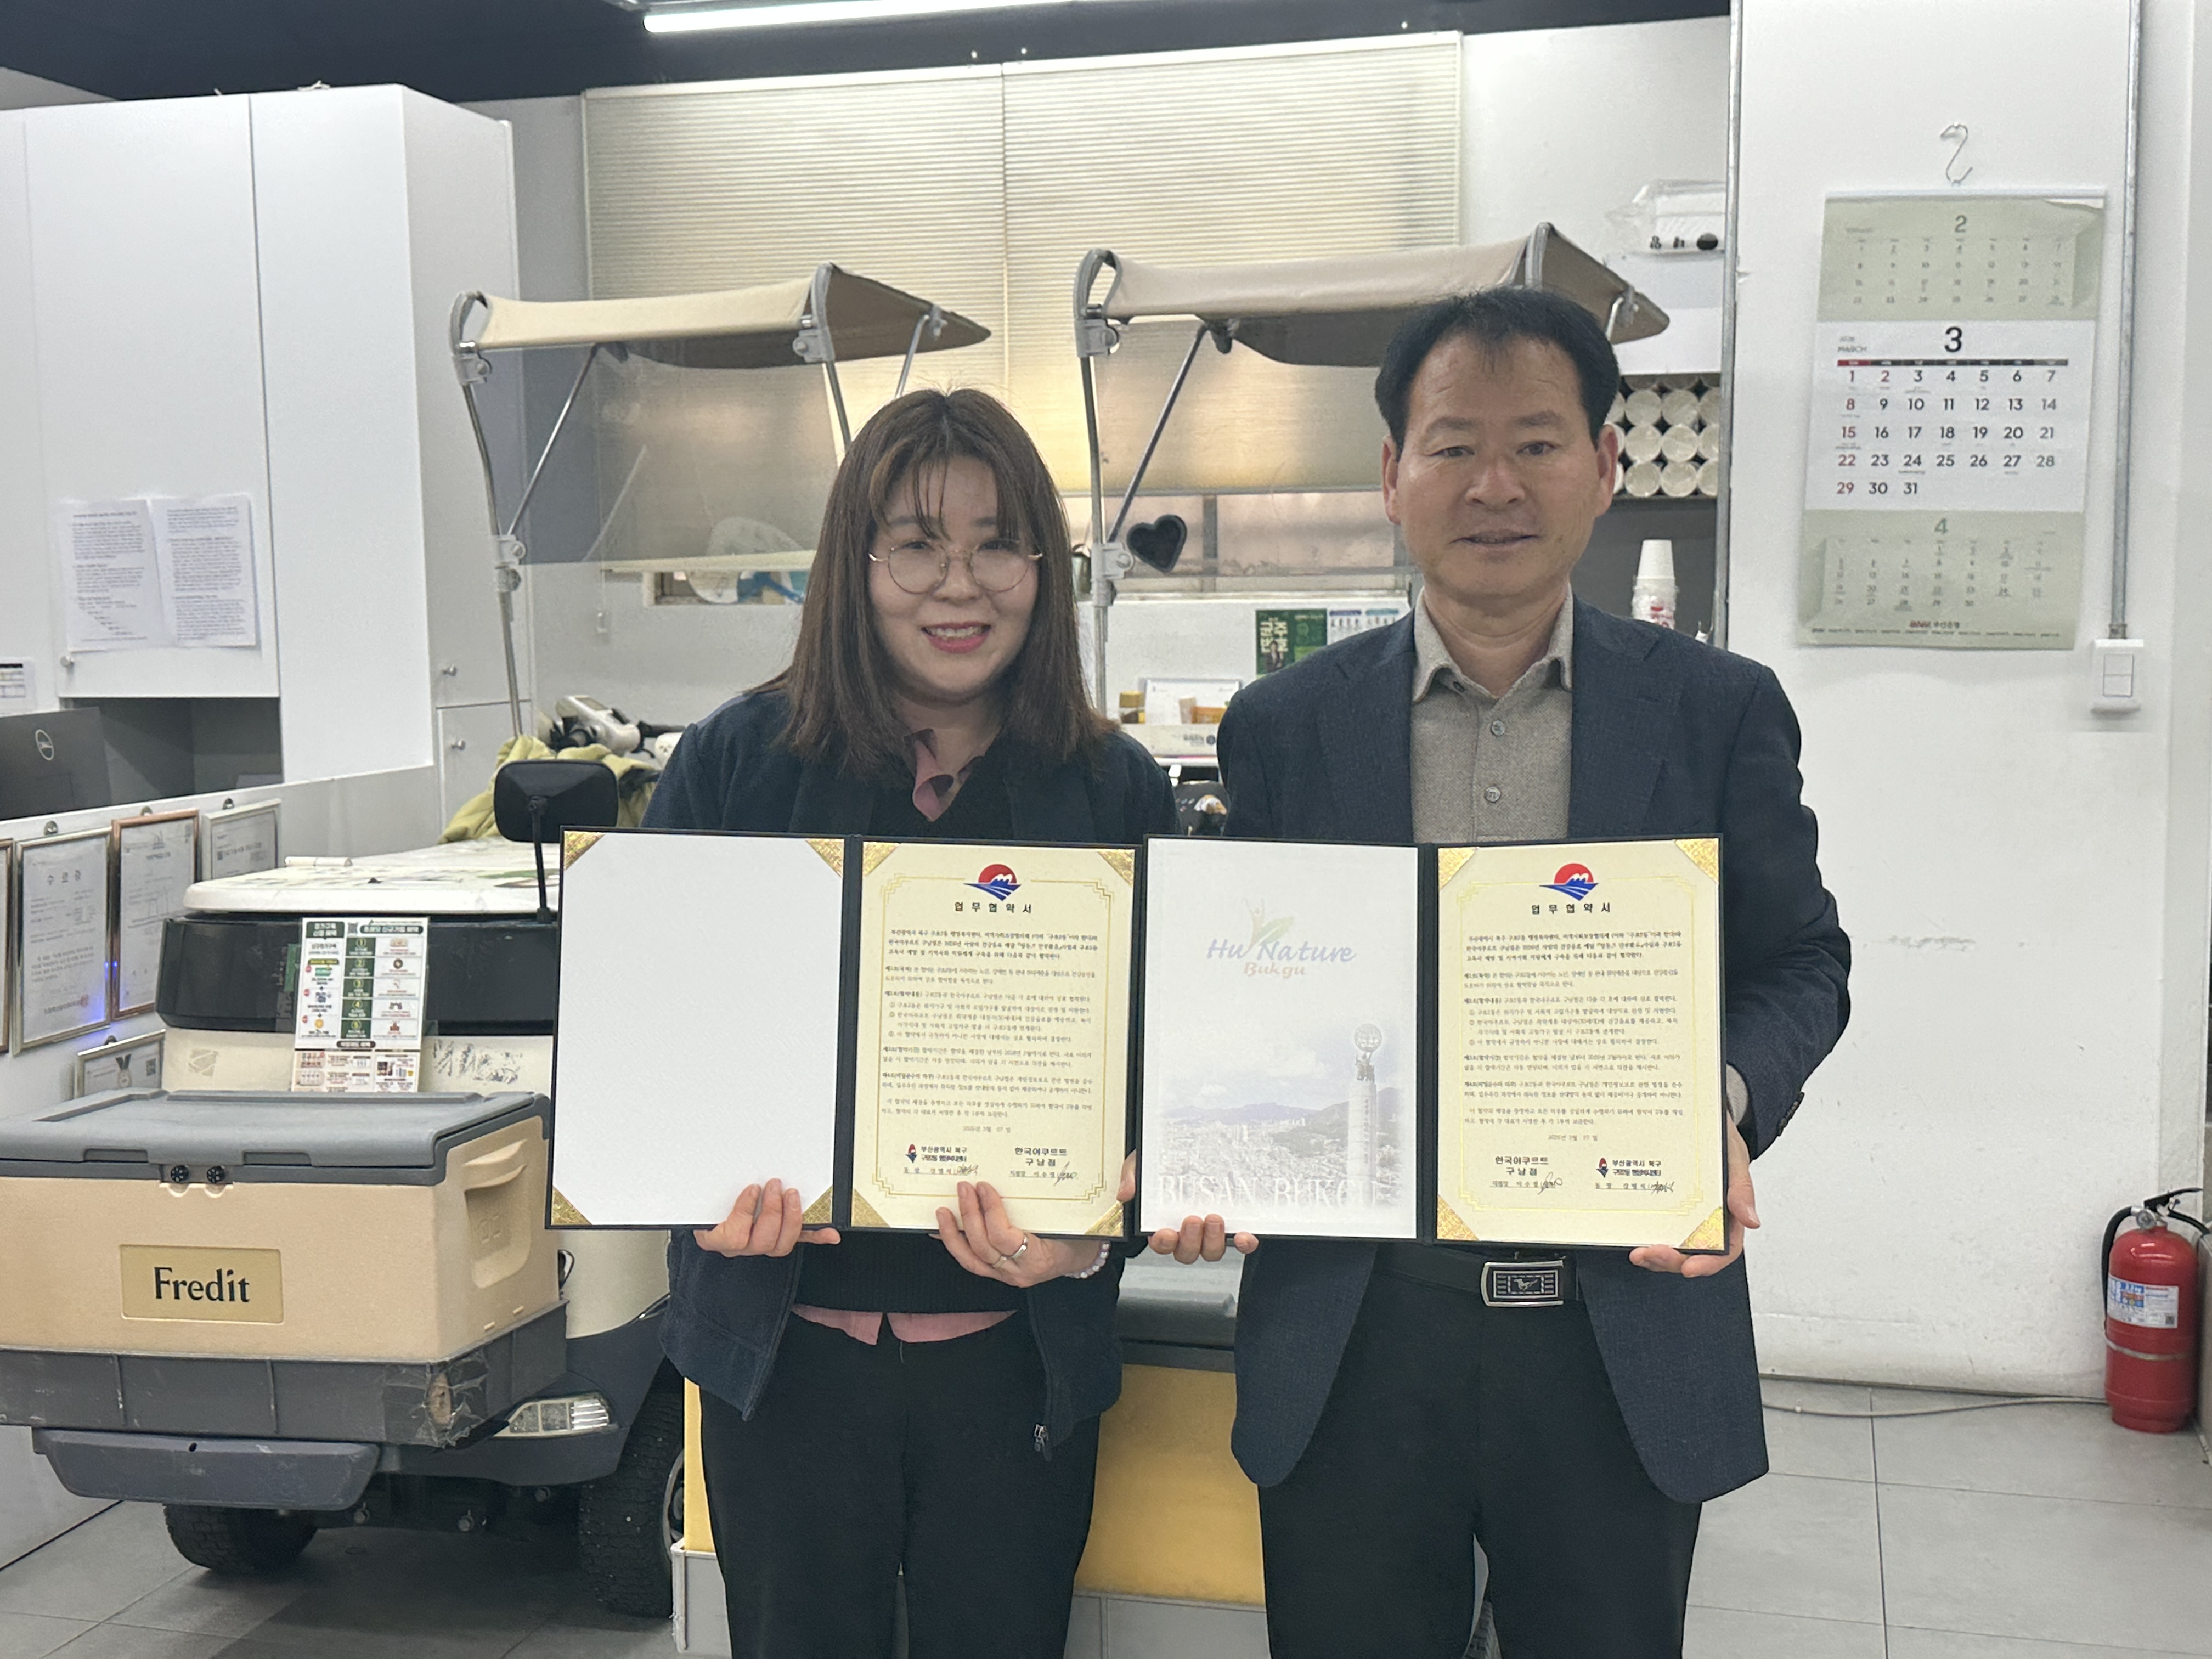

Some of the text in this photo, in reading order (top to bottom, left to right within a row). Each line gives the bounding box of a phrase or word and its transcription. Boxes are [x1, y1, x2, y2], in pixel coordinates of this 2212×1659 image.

[1955, 215, 1967, 233] 2
[1944, 326, 1962, 353] 3
[1850, 370, 2056, 382] 1 2 3 4 5 6 7
[1846, 398, 2056, 411] 8 9 10 11 12 13 14
[1842, 426, 2054, 439] 15 16 17 18 19 20 21
[1838, 454, 2055, 467] 22 23 24 25 26 27 28
[1837, 482, 1917, 494] 29 30 31
[1934, 518, 1948, 534] 4
[1207, 939, 1357, 962] Hu Nature
[1243, 962, 1307, 979] Bukgu
[154, 1266, 250, 1302] Fredit
